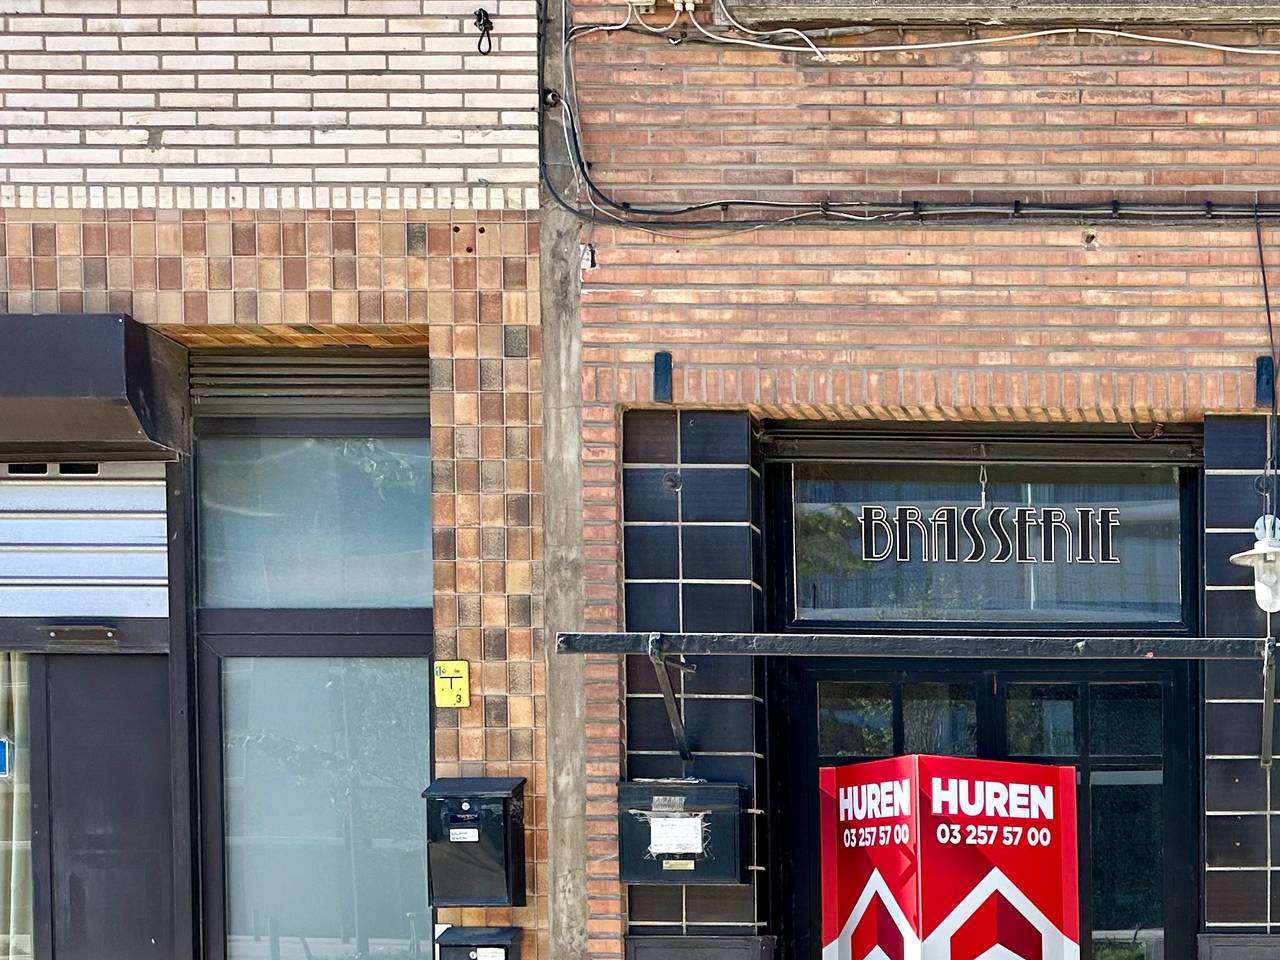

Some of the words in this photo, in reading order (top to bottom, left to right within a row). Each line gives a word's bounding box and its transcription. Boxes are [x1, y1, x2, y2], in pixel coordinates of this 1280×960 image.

[858, 505, 1120, 563] BRASSERIE
[839, 779, 911, 822] HUREN
[931, 777, 1054, 820] HUREN
[843, 828, 857, 848] 03
[858, 827, 877, 847] 257
[879, 825, 892, 846] 57
[893, 823, 910, 844] 00
[936, 823, 961, 844] 03
[965, 825, 999, 846] 257
[1002, 826, 1024, 846] 57
[1027, 827, 1051, 847] 00
